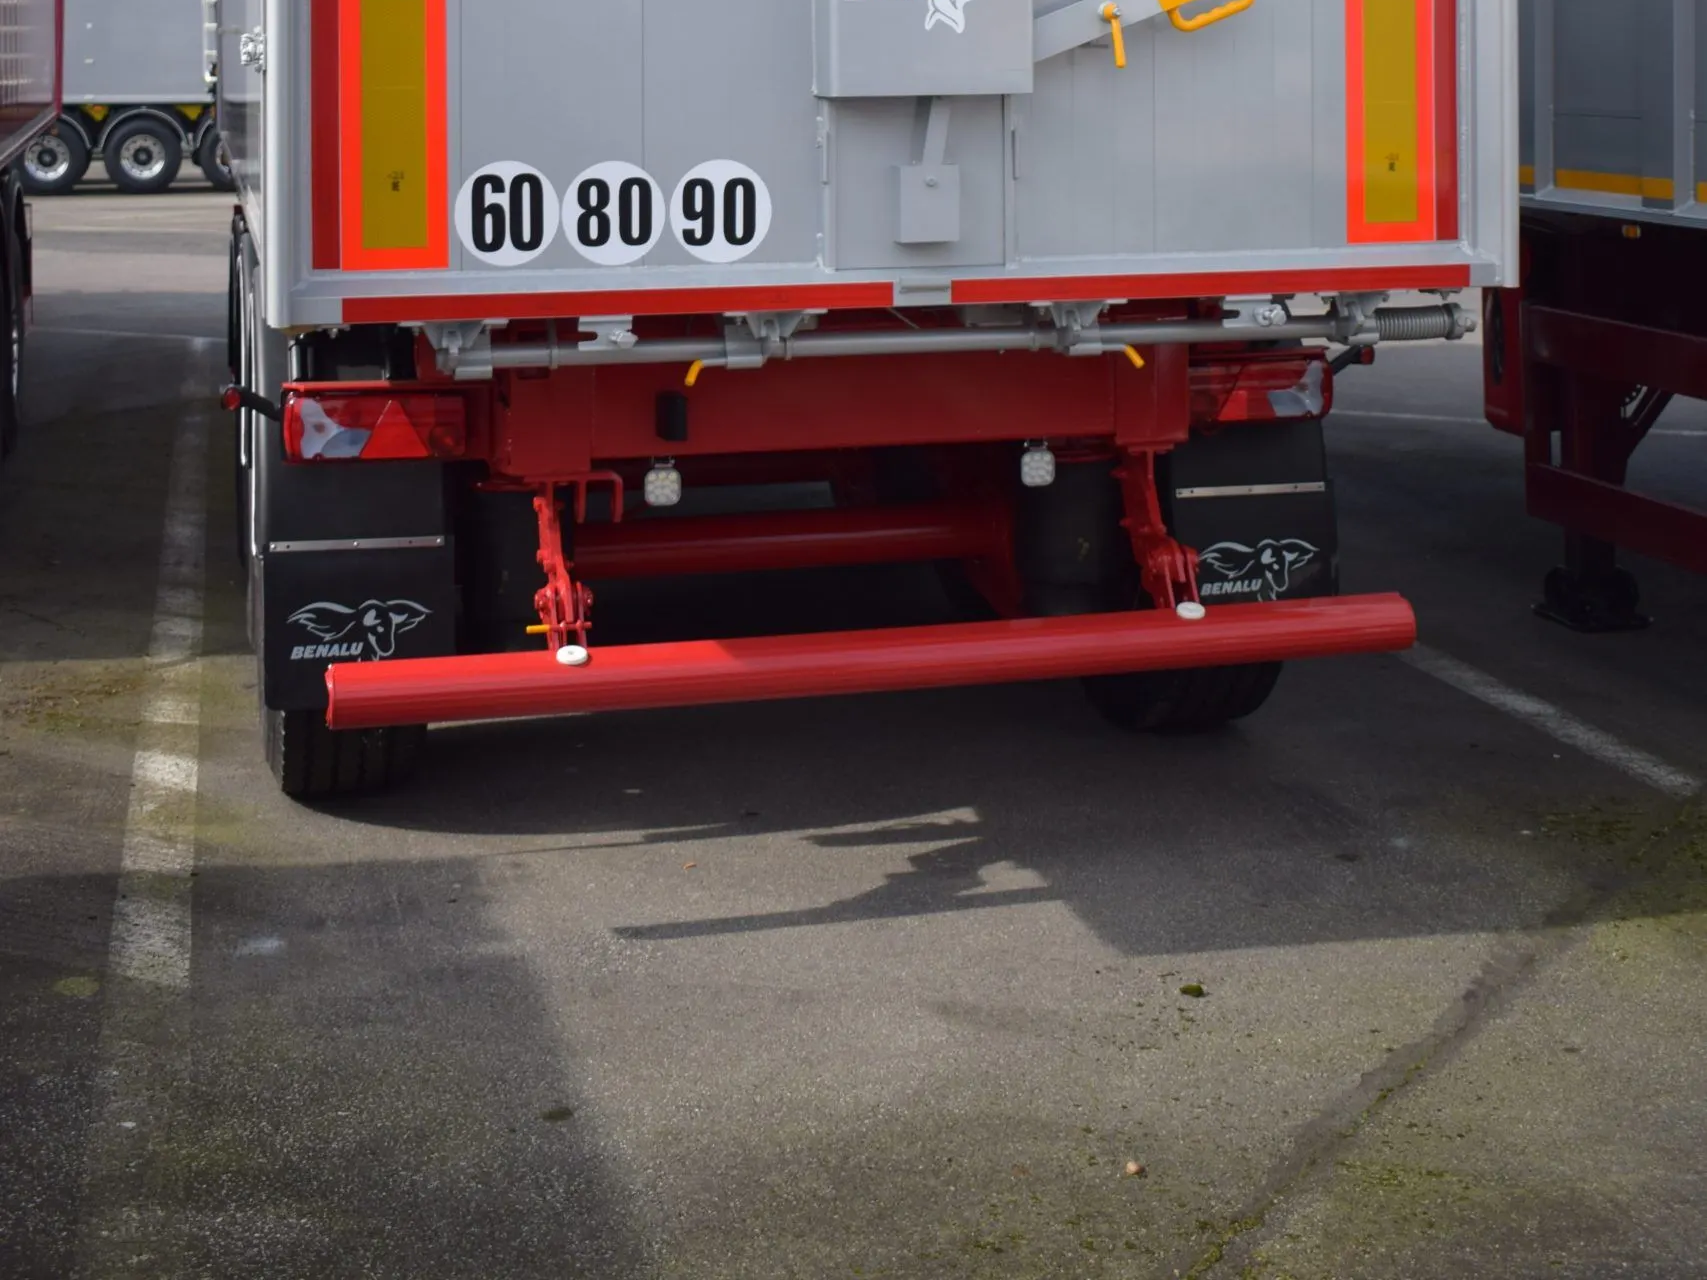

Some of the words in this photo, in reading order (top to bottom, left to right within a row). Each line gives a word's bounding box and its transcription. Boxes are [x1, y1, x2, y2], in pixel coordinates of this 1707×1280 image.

[471, 172, 544, 253] 60
[577, 177, 652, 247] 80
[682, 177, 757, 246] 90
[1200, 578, 1262, 596] BENALU
[290, 642, 364, 660] BENALU
